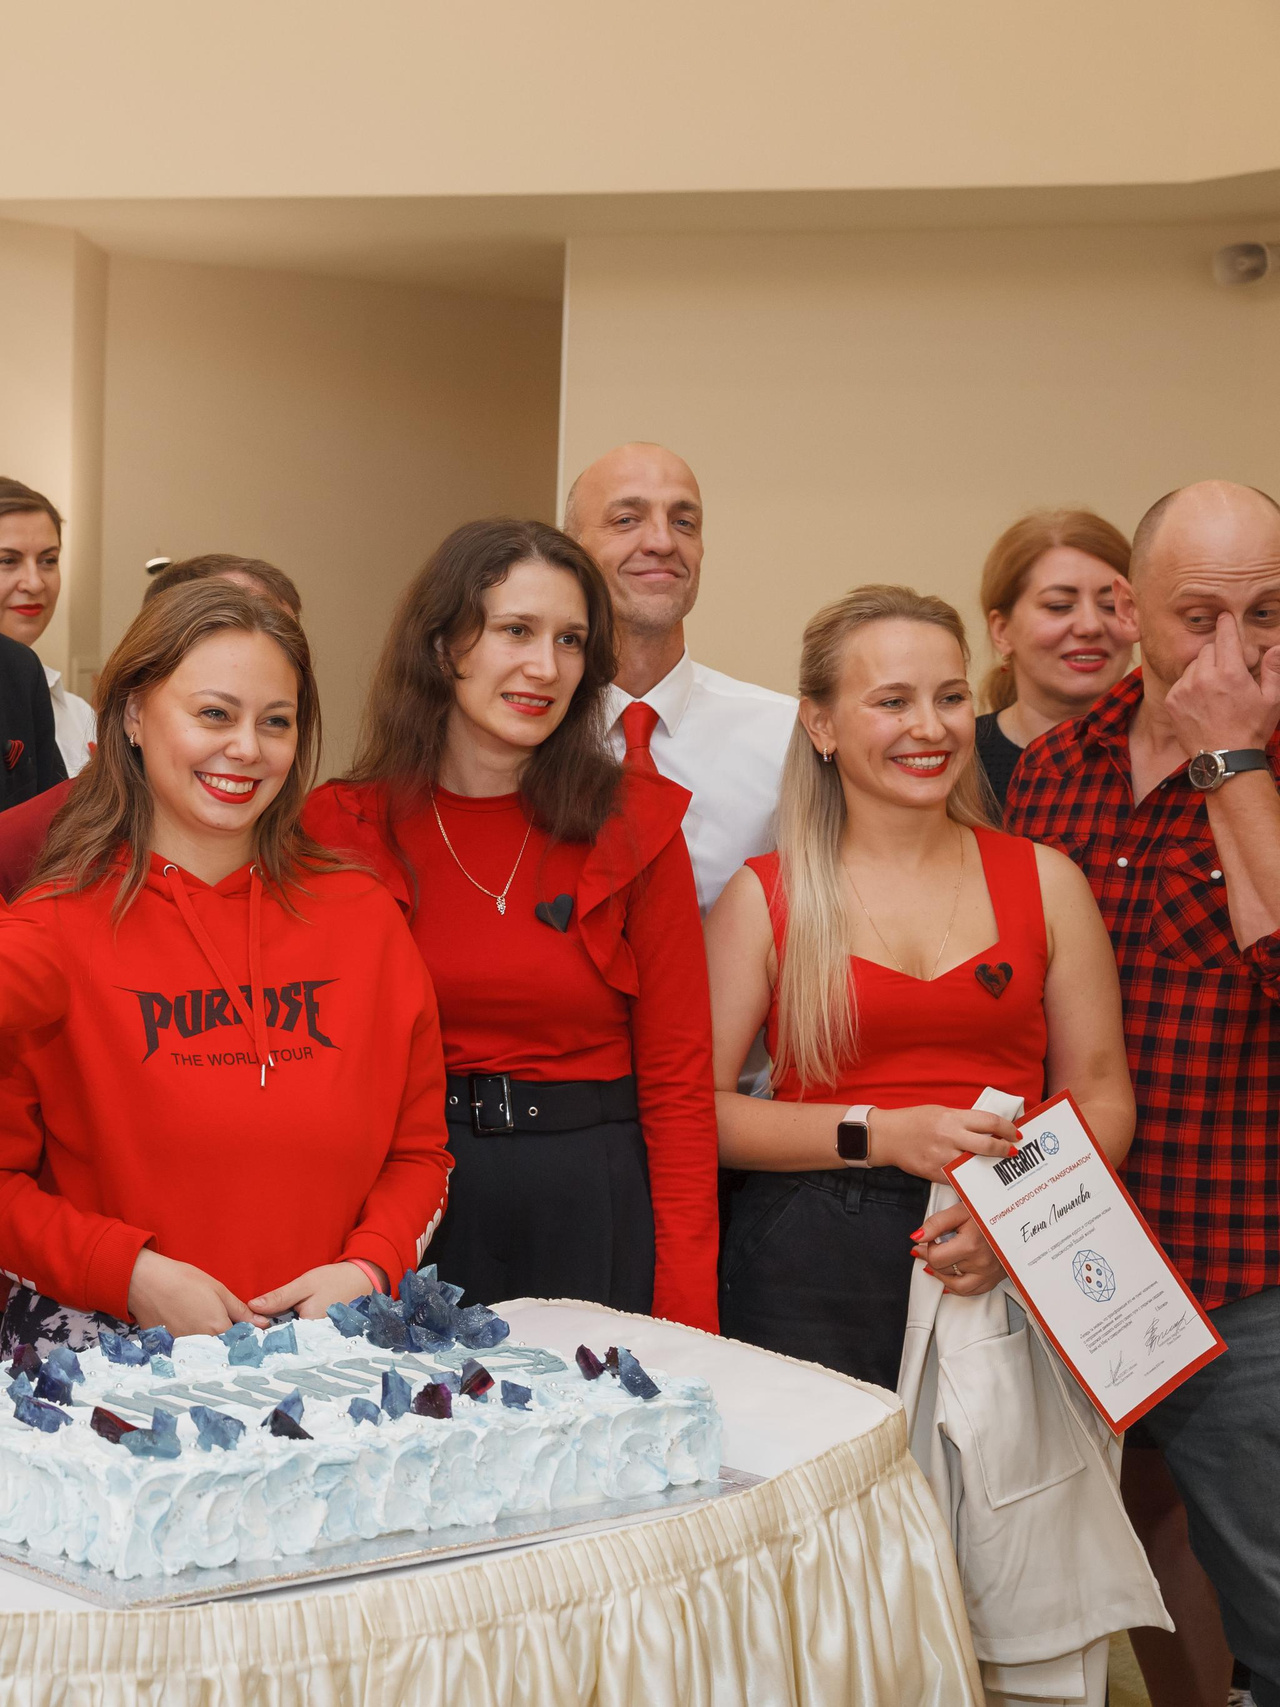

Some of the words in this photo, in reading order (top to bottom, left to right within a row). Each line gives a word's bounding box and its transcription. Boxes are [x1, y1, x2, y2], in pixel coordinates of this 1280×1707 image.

[171, 1052, 204, 1067] THE
[207, 1051, 259, 1067] WORL
[270, 1047, 313, 1063] TOUR
[992, 1138, 1045, 1186] INTEGRITY
[989, 1203, 1016, 1225] СЕРТИФИКАТ
[1014, 1191, 1034, 1207] ВТОРОГО
[1033, 1182, 1048, 1194] КУРСА
[1019, 1220, 1047, 1242] Елена
